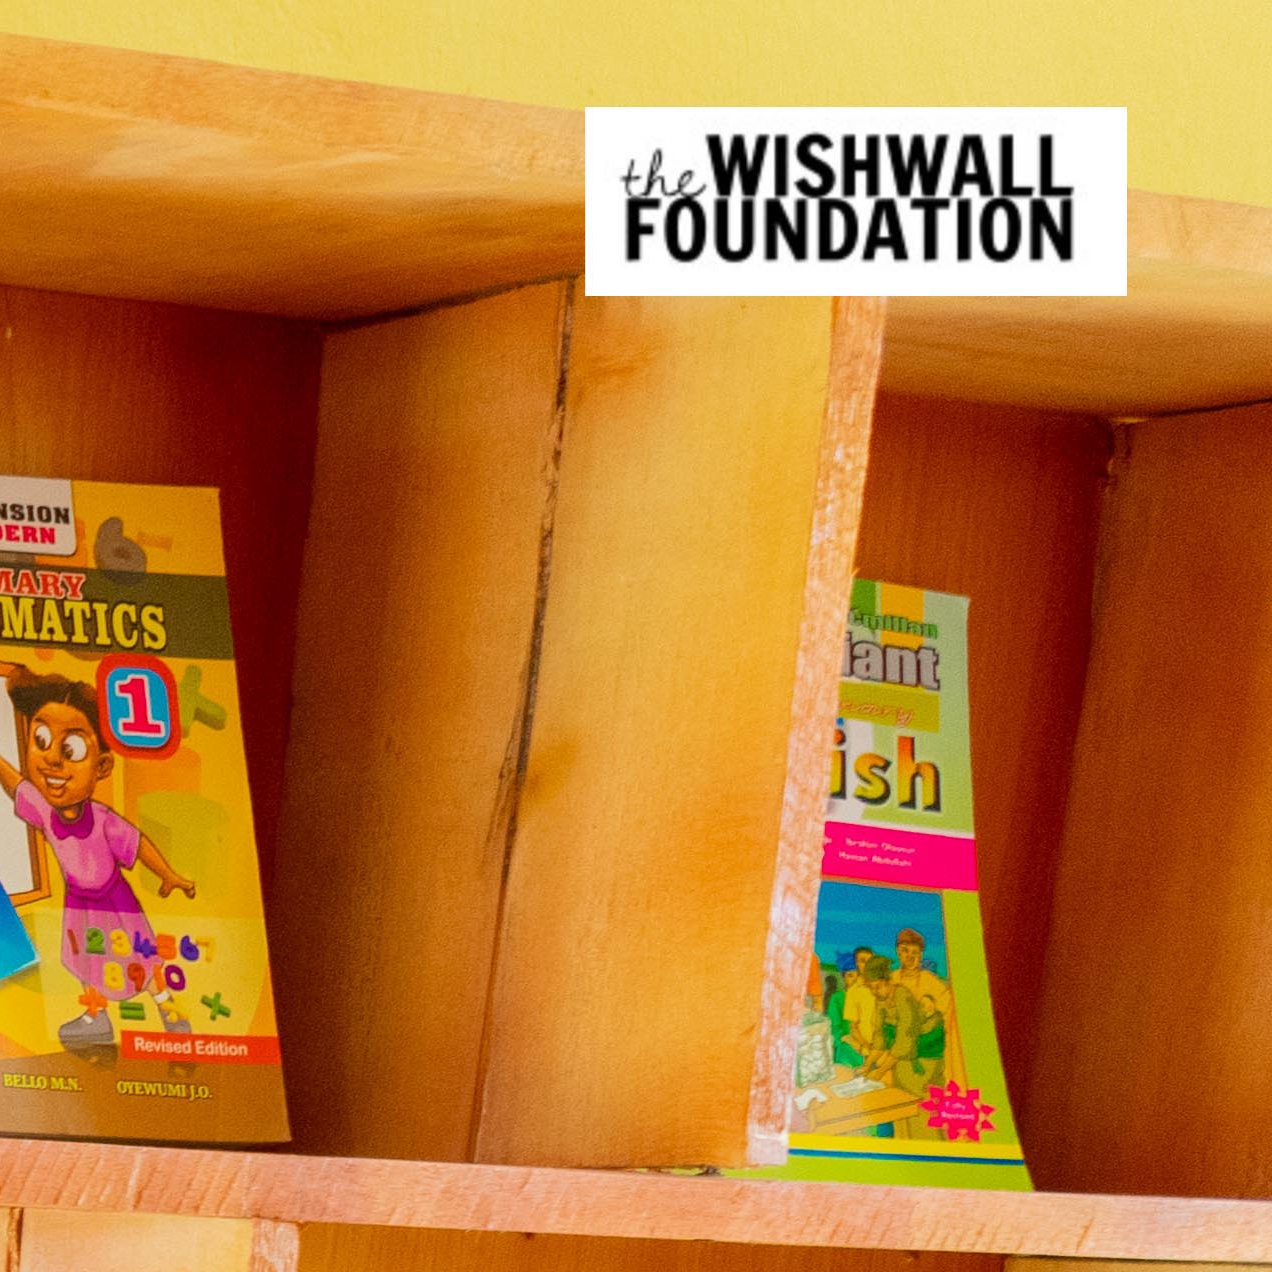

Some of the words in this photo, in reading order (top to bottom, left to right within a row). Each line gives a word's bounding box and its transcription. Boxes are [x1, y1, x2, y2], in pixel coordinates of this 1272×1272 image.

[116, 675, 166, 736] 1
[135, 1037, 190, 1054] Revised
[193, 1040, 249, 1056] Edition
